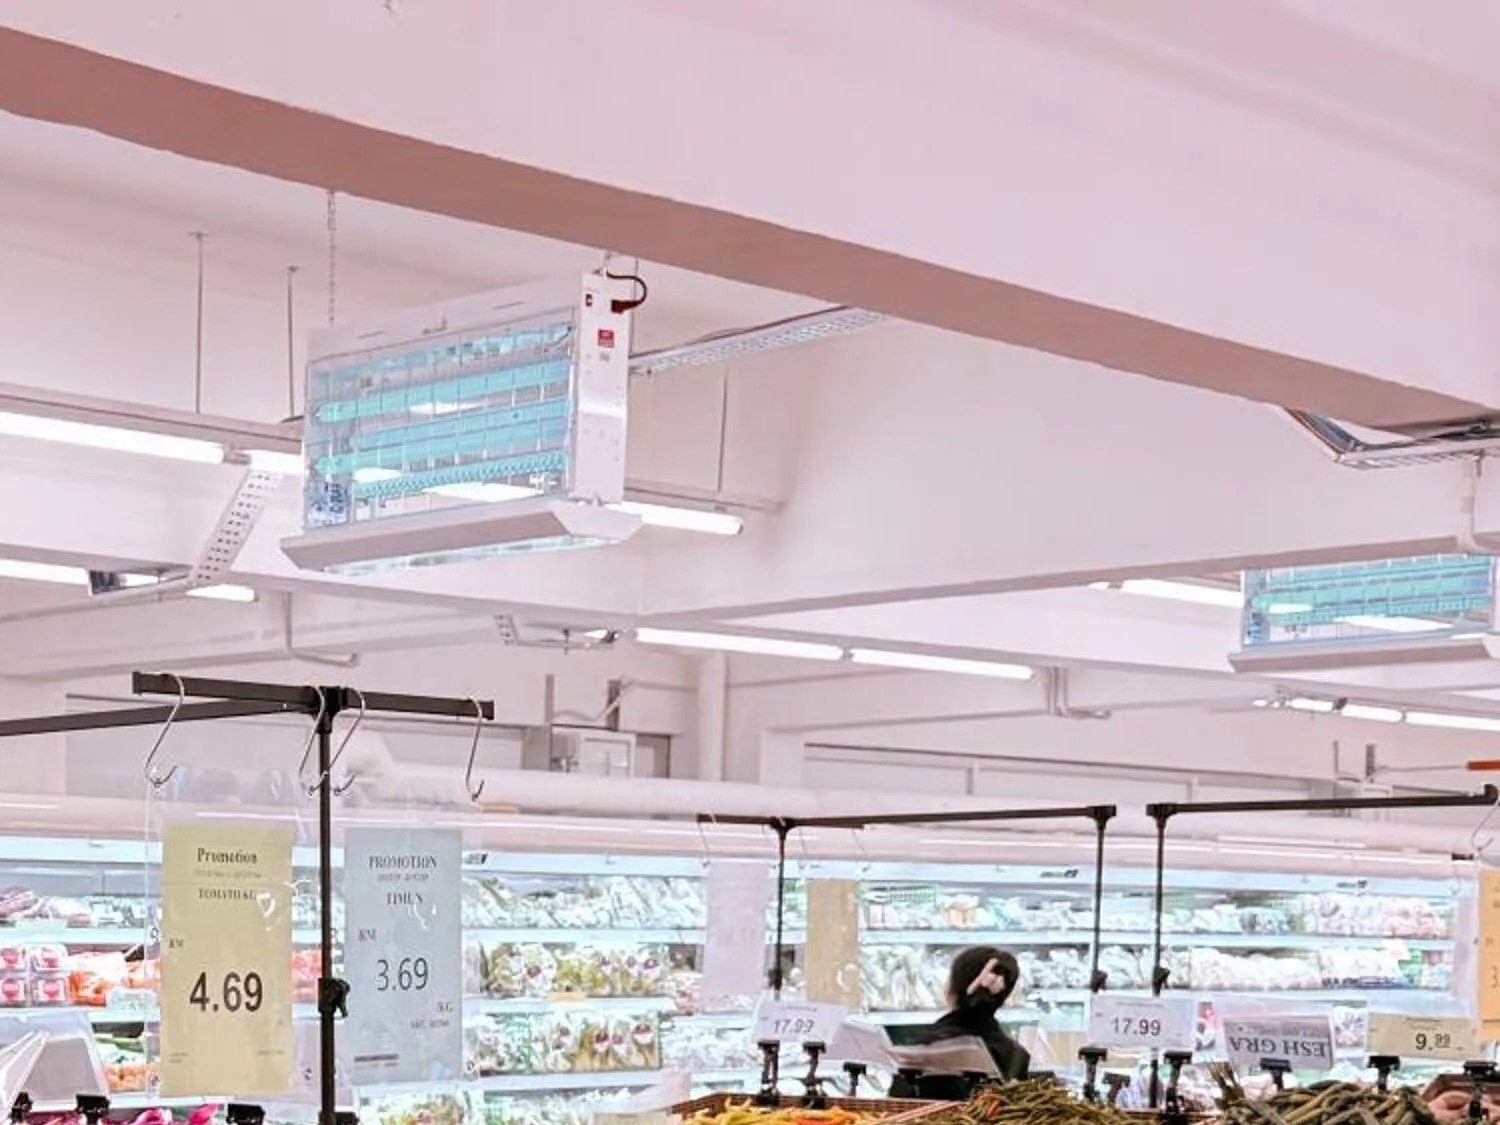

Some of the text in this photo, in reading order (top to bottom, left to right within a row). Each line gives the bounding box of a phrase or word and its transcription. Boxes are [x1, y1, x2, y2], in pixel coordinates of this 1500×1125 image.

[197, 847, 258, 864] Promotion
[369, 855, 437, 869] PROMOTION
[377, 957, 428, 991] 3.69
[189, 971, 263, 1012] 4.69
[1111, 1017, 1162, 1037] 17.99
